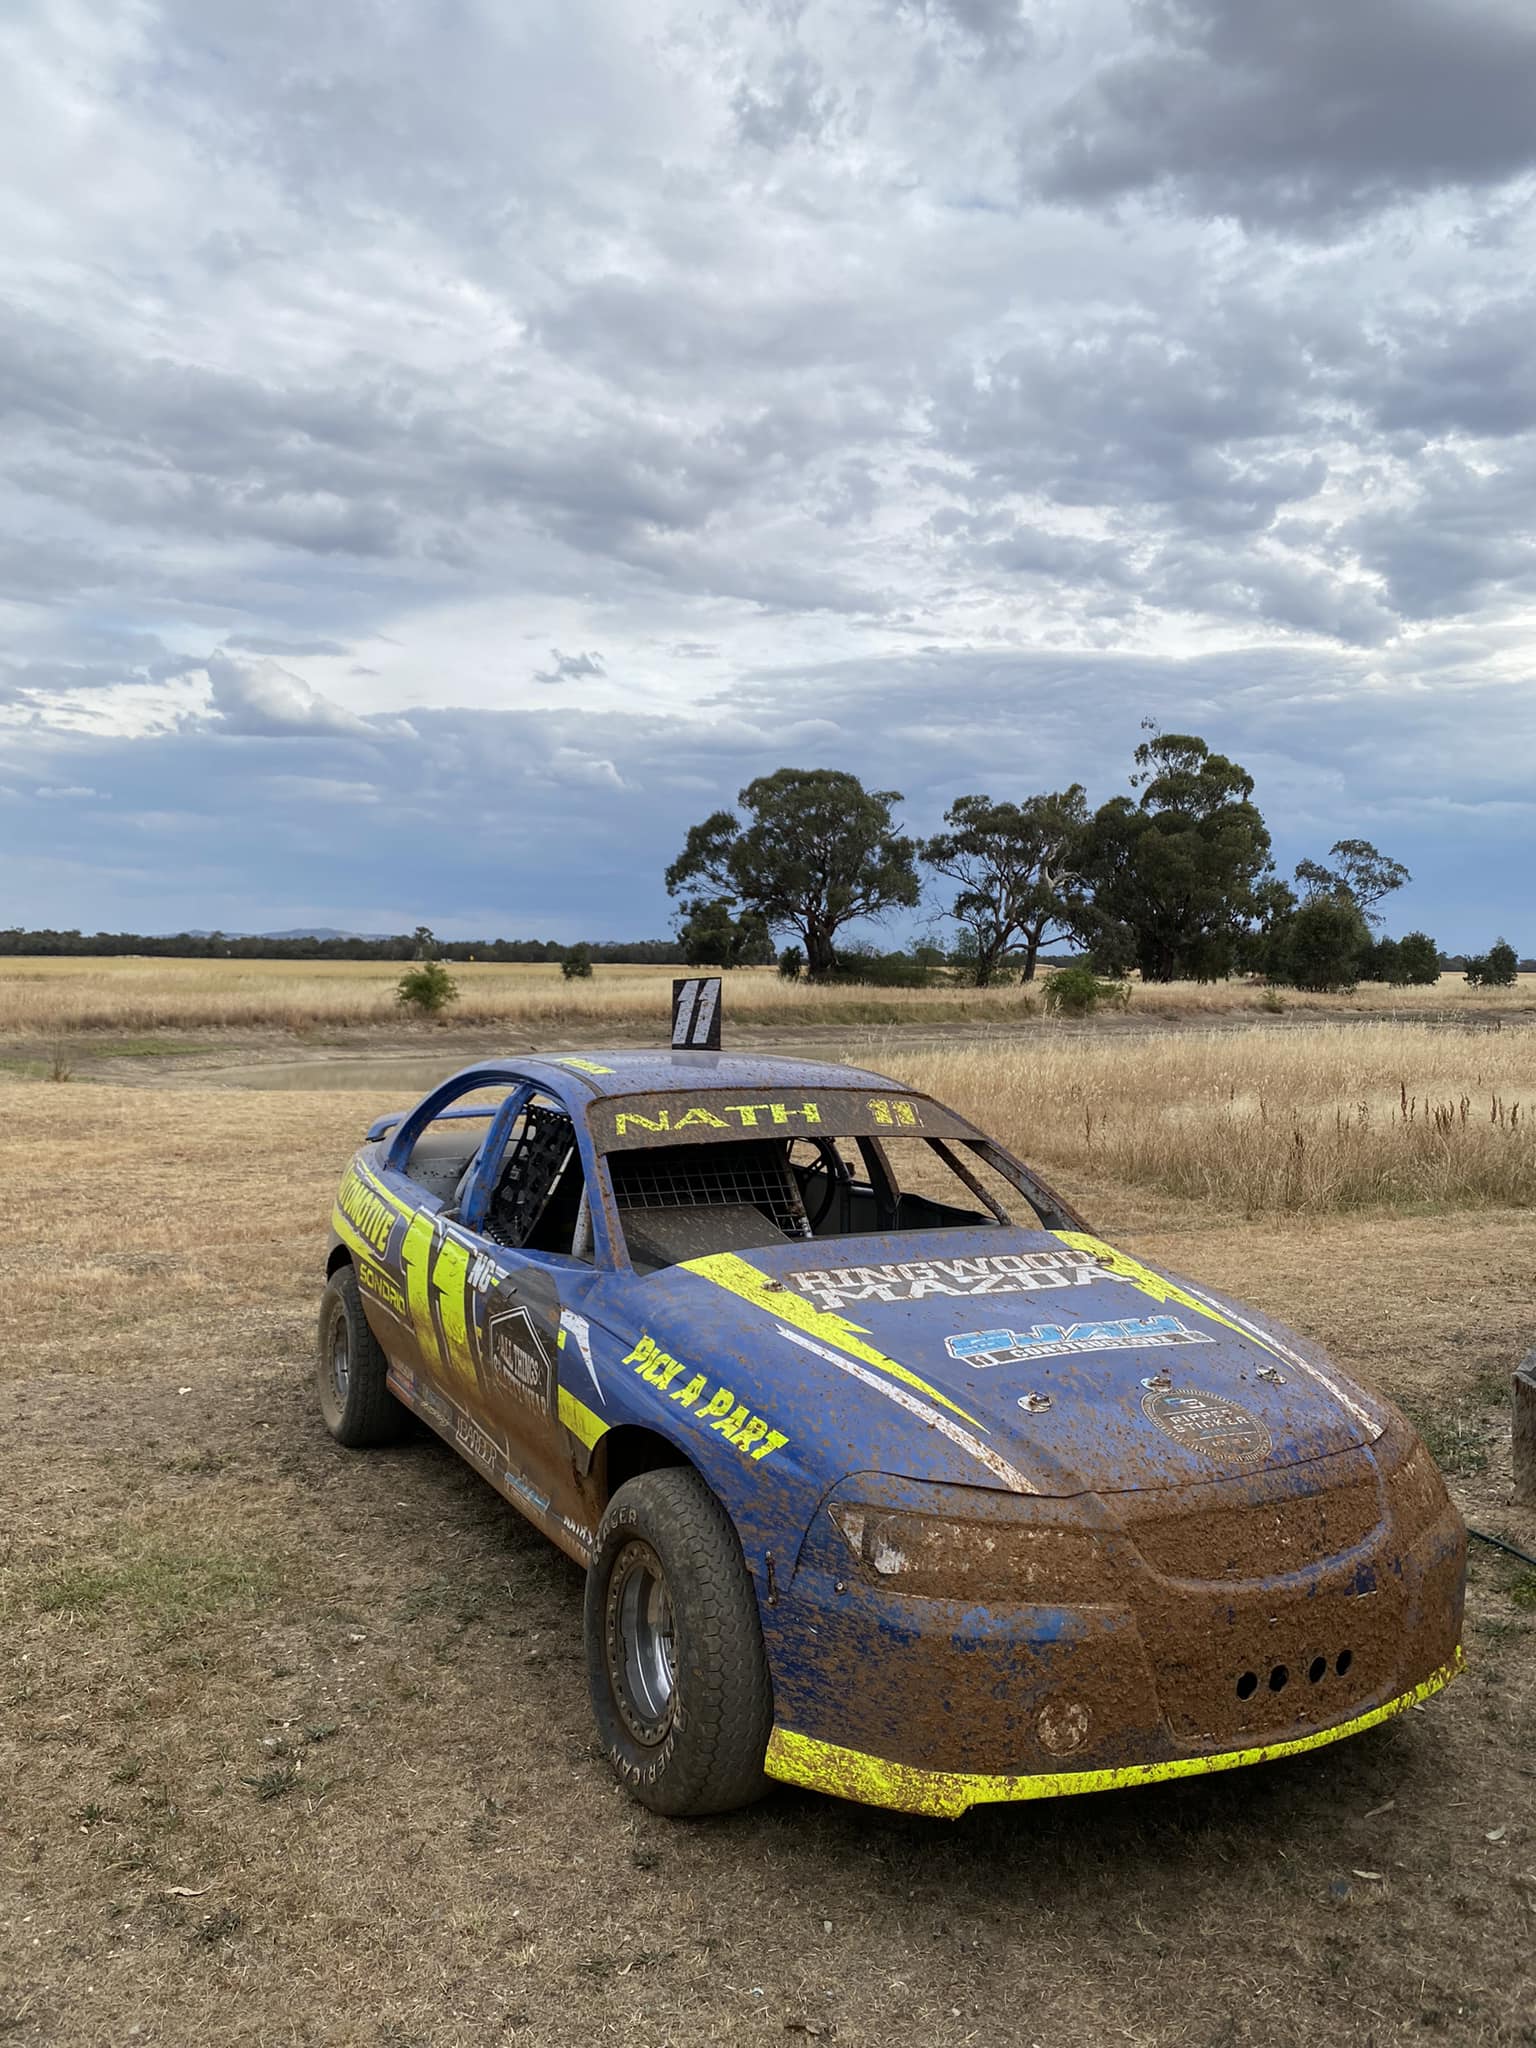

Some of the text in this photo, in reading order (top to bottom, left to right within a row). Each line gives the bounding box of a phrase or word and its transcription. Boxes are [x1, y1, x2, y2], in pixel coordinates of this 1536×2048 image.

[672, 980, 721, 1044] 11
[616, 1099, 921, 1137] NATH 11
[789, 1250, 1098, 1292] RINGWOOD
[811, 1265, 1134, 1311] MAZDA
[621, 1335, 790, 1461] PICK A PART
